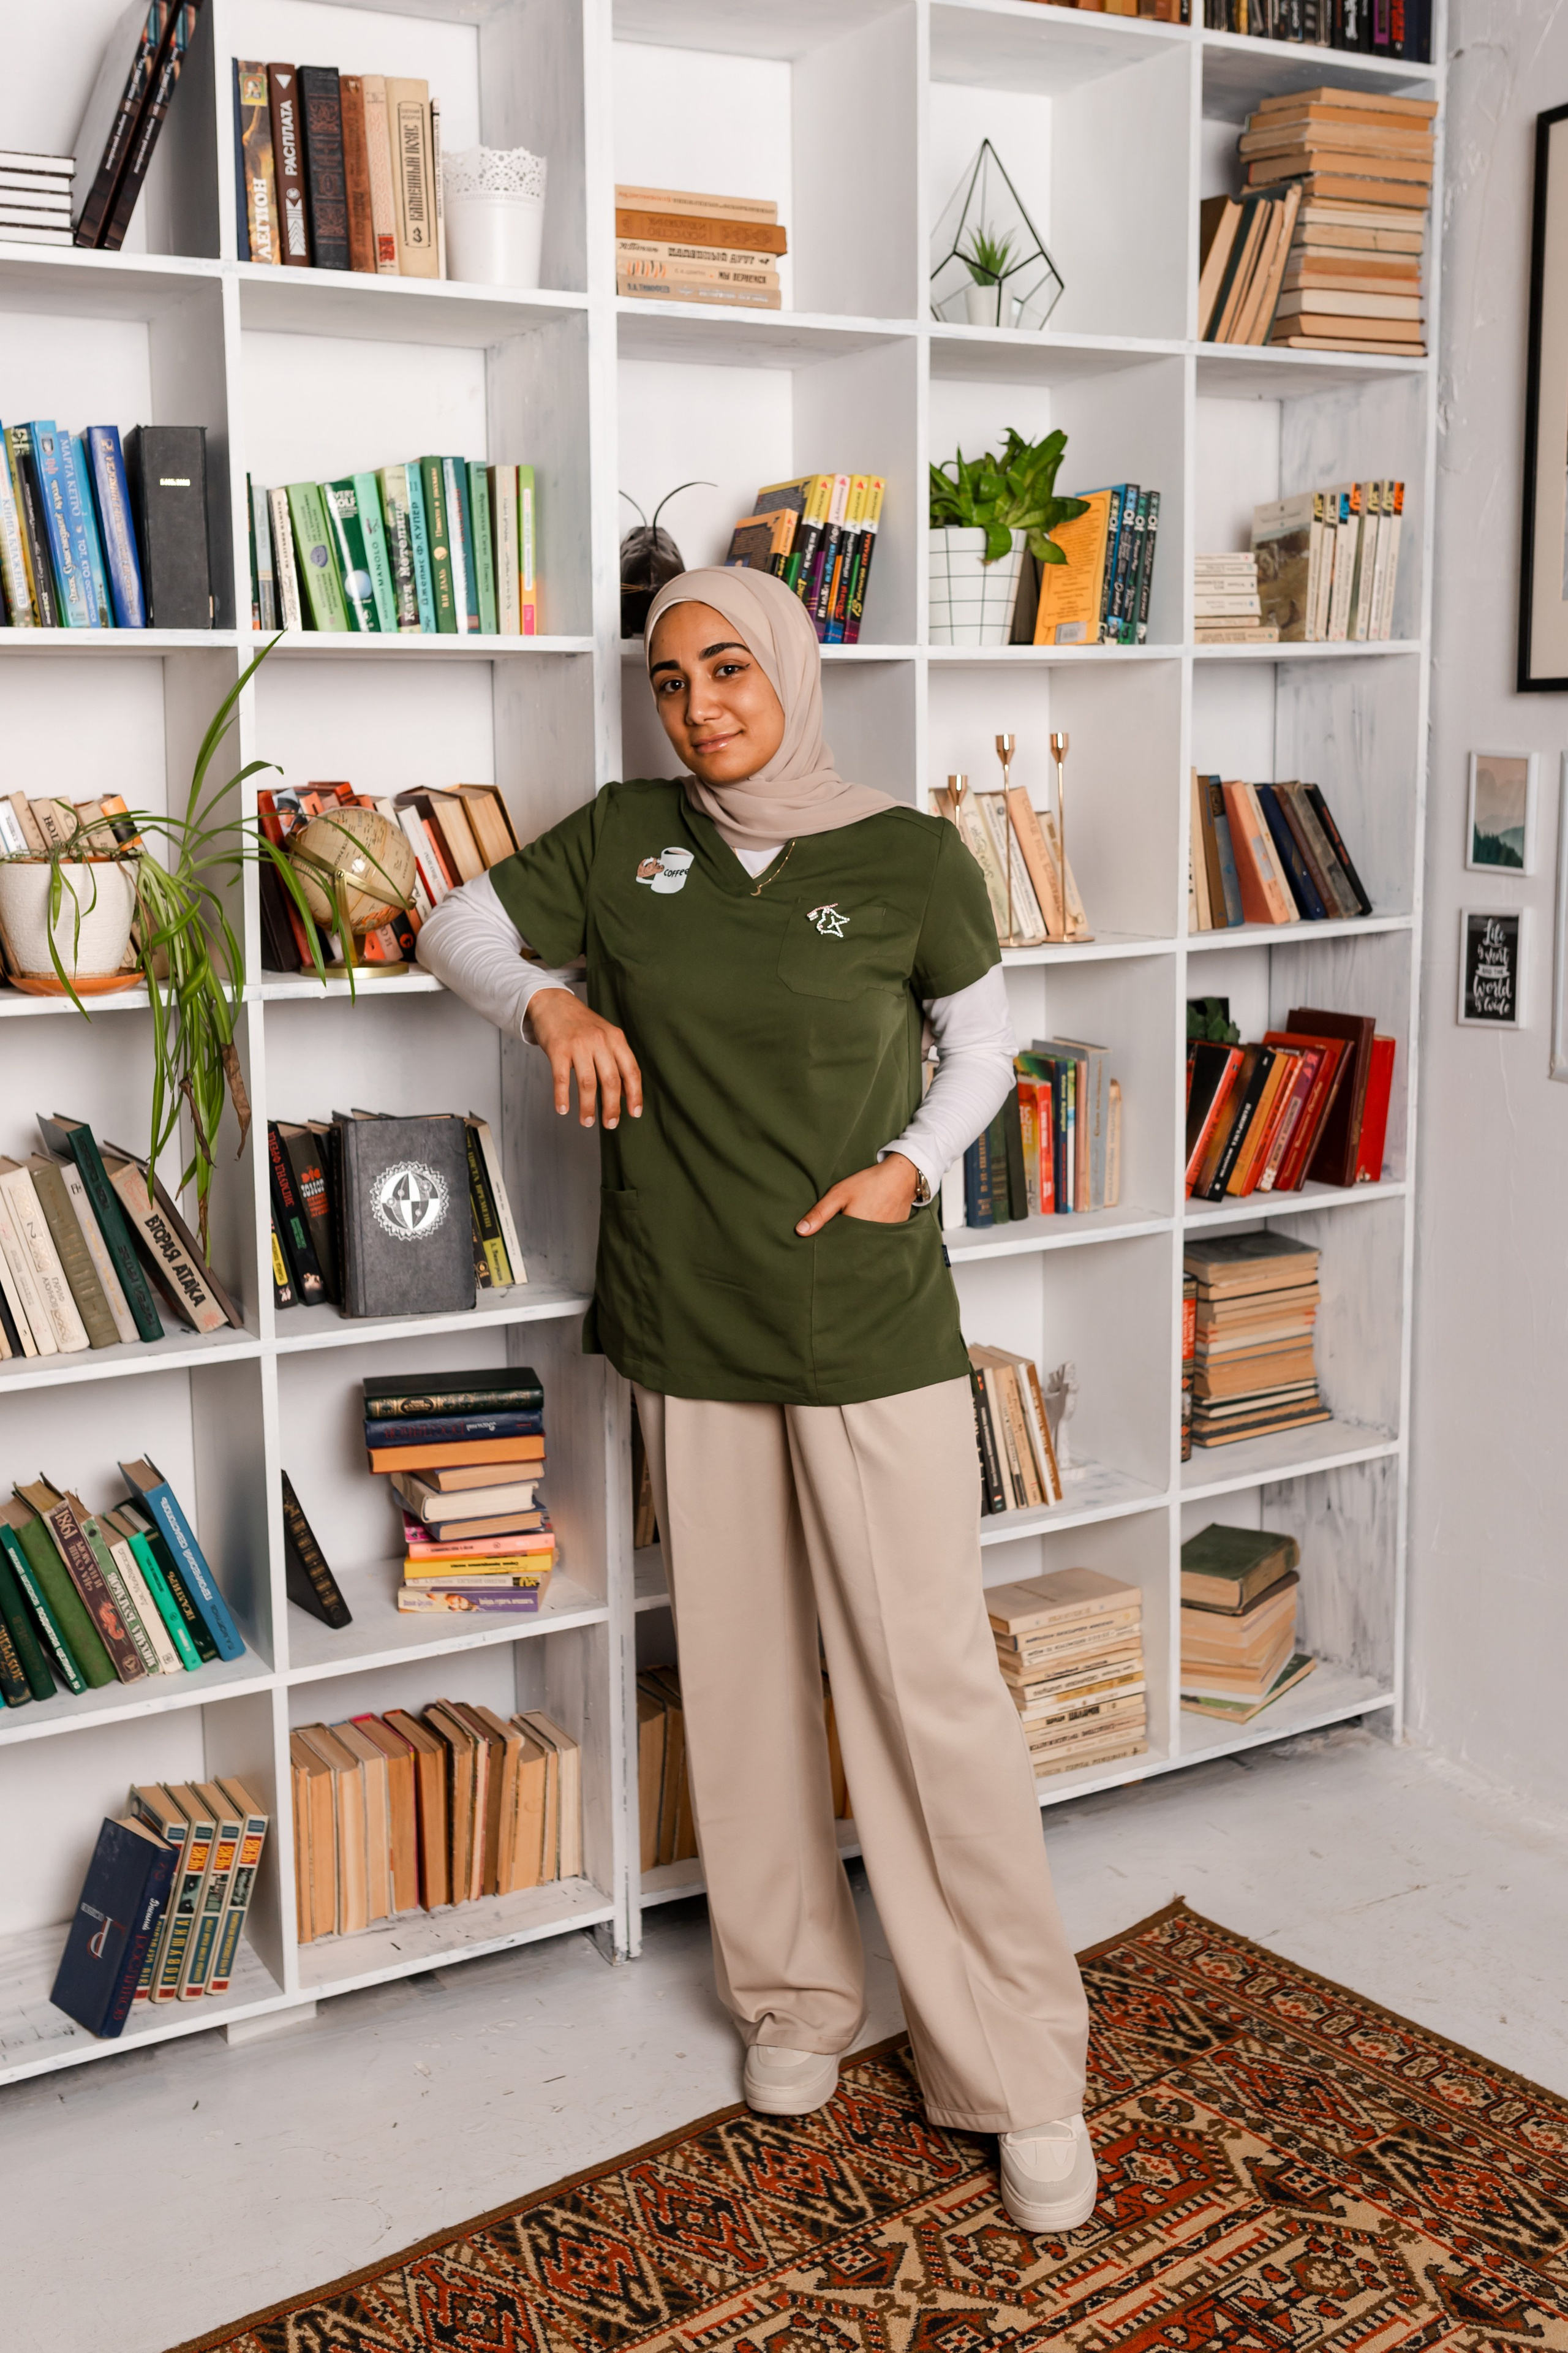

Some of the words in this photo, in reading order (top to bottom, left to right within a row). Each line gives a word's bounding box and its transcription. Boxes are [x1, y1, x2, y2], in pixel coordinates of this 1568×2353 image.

[278, 100, 298, 176] РАСПЛАТА
[402, 125, 420, 154] ПОЯС
[404, 156, 423, 222] КАМЕННЫЙ
[251, 177, 273, 260] ЛЕГИОН
[59, 437, 74, 477] МАРТА
[66, 479, 81, 516] КЕТРО
[410, 500, 423, 540] КУПЕР
[477, 492, 486, 531] Франсуаза
[1, 498, 15, 536] КНИГА
[8, 537, 27, 605] БЛАЖЕНСТВ
[80, 559, 91, 577] КТО
[401, 584, 415, 621] Катя
[438, 568, 448, 592] ДАЛЬ
[1482, 918, 1506, 947] Life
[143, 1212, 183, 1263] ВТОРАЯ
[171, 1259, 208, 1307] АТАКА
[158, 1496, 189, 1550] СЕВАСТОПОЛЬ
[105, 1571, 137, 1623] БУЛГАКОВ
[165, 1569, 197, 1622] ПСАЛТИРЬ
[182, 1547, 213, 1602] ГЕРОИЧЕСКИЙ
[129, 1623, 158, 1669] МИХАИЛ
[160, 1917, 192, 1984] ЛОВУШКА
